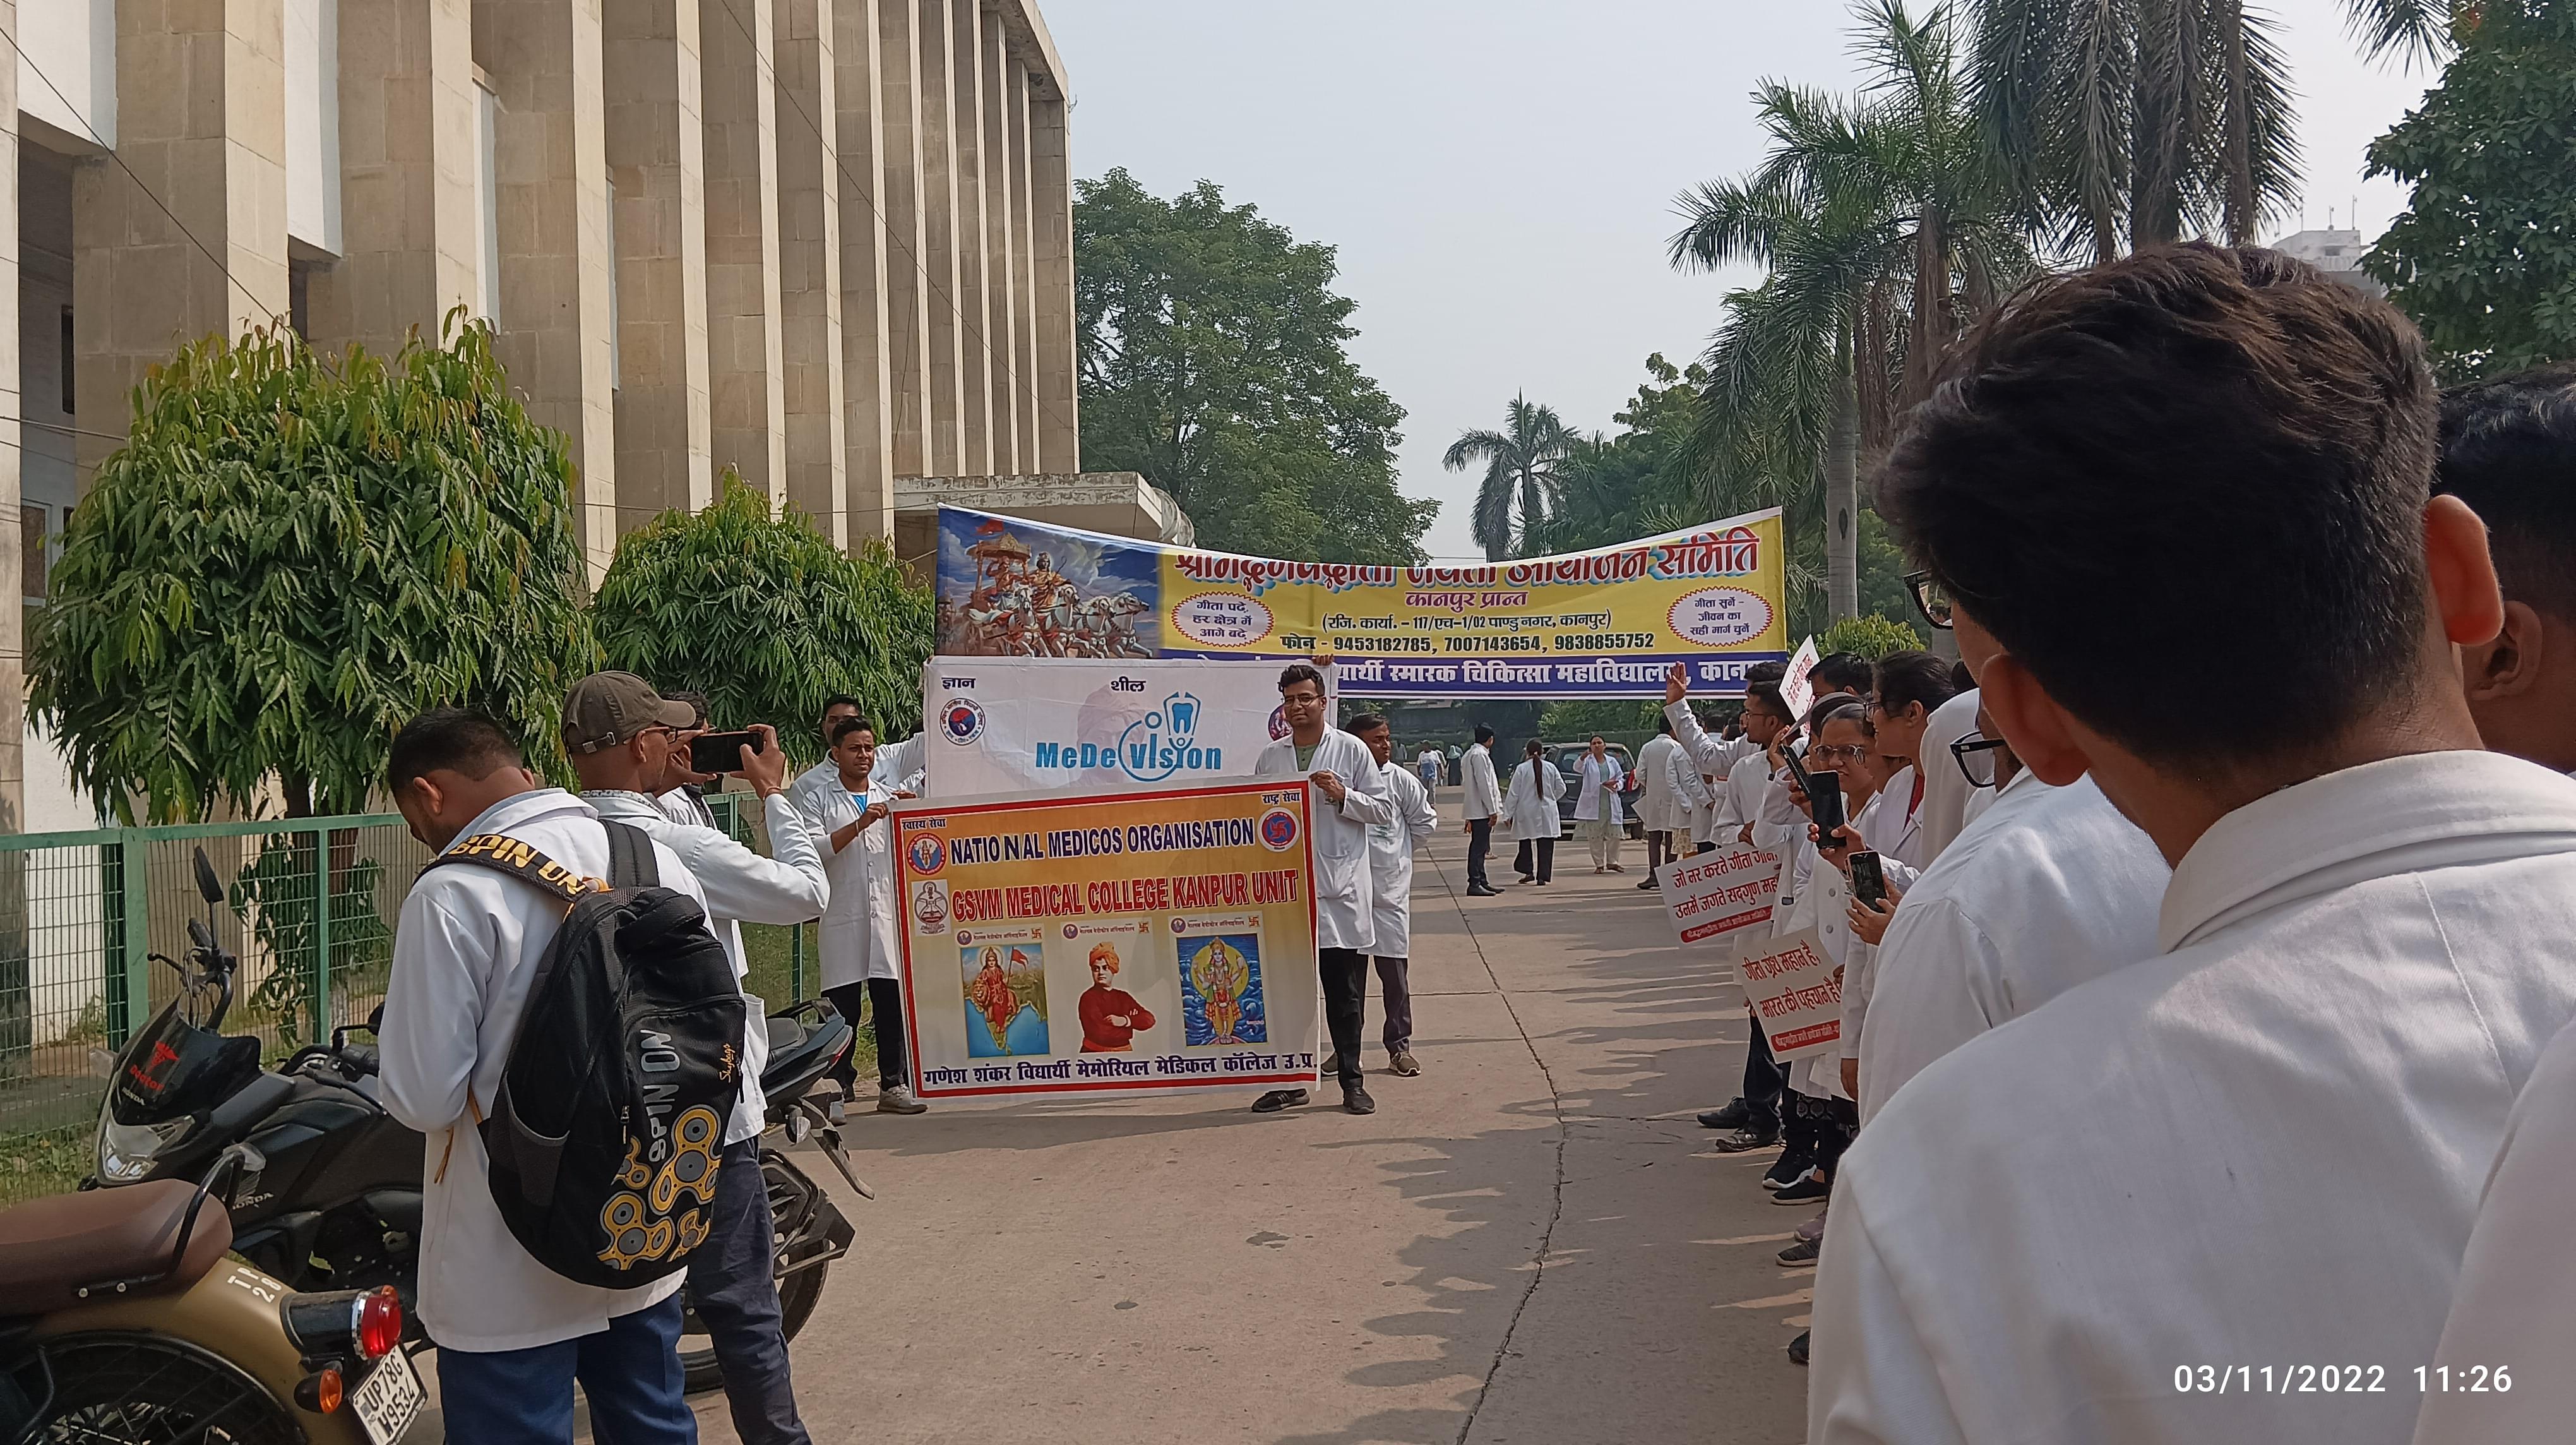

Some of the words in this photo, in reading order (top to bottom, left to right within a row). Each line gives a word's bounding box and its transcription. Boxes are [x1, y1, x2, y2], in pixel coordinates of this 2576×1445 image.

[1655, 526, 1760, 573] समिति
[1196, 600, 1223, 611] गीता
[1404, 591, 1476, 613] कानपुर
[1479, 591, 1529, 609] प्रान्त
[1694, 598, 1715, 608] गीता
[1192, 615, 1210, 624] हर
[1213, 614, 1238, 625] क्षेत्र
[1322, 613, 1356, 633] (रजि.
[1359, 613, 1397, 629] कार्या.
[1488, 616, 1518, 632] पाण्डु
[1521, 616, 1557, 628] नगर,
[1559, 608, 1612, 630] कानपुर)
[1690, 624, 1708, 635] सही
[1712, 623, 1731, 634] मार्ग
[1734, 622, 1750, 635] चुनें
[1698, 610, 1725, 621] जीवन
[1727, 611, 1741, 621] का
[1200, 628, 1225, 637] आगे
[1280, 633, 1316, 651] फोन
[1333, 637, 1438, 654] 9453182785,
[1445, 635, 1548, 653] 7007143654,
[1554, 633, 1654, 651] 9838855752
[941, 677, 976, 689] ज्ञान
[1111, 676, 1147, 692] शील
[1388, 665, 1459, 683] स्मारक
[1462, 659, 1552, 683] चिकित्सा
[1556, 658, 1691, 687] महाविद्याल,
[1262, 794, 1280, 805] राष्ट्र
[1282, 791, 1301, 802] सेवा
[929, 817, 946, 828] सेवा
[1047, 827, 1123, 858] MEDICOS
[1127, 818, 1255, 853] ORGANISATION
[448, 835, 537, 868] SPIN
[538, 860, 586, 894] ON
[1673, 868, 1687, 889] जो
[1686, 867, 1702, 884] नर
[1702, 856, 1729, 878] करते
[1728, 851, 1753, 870] गीता
[952, 888, 1003, 923] GSVM
[1006, 882, 1085, 920] MEDICAL
[1087, 876, 1170, 914] COLLEGE
[1172, 872, 1249, 909] KANPUR
[1251, 868, 1299, 905] UNIT
[1673, 894, 1700, 918] उनमें
[1699, 887, 1727, 911] जगते
[1742, 957, 1767, 981] गीता
[1777, 949, 1810, 971] महान
[1800, 940, 1821, 966] है,
[1759, 997, 1787, 1017] भारत
[1781, 986, 1801, 1011] की
[1796, 985, 1832, 1009] पहचान
[640, 1029, 680, 1072] ON
[130, 1064, 165, 1092] Doctor
[924, 1065, 968, 1085] गणेश
[973, 1062, 1012, 1082] शंकर
[1017, 1059, 1071, 1080] विद्यार्थी
[1076, 1057, 1150, 1077] मेमोरियल
[1155, 1055, 1217, 1074] मेडिकल
[1221, 1052, 1277, 1070] कॉलेज
[643, 1084, 679, 1162] SPIN
[227, 1267, 259, 1290] TP
[253, 1277, 282, 1304] 28
